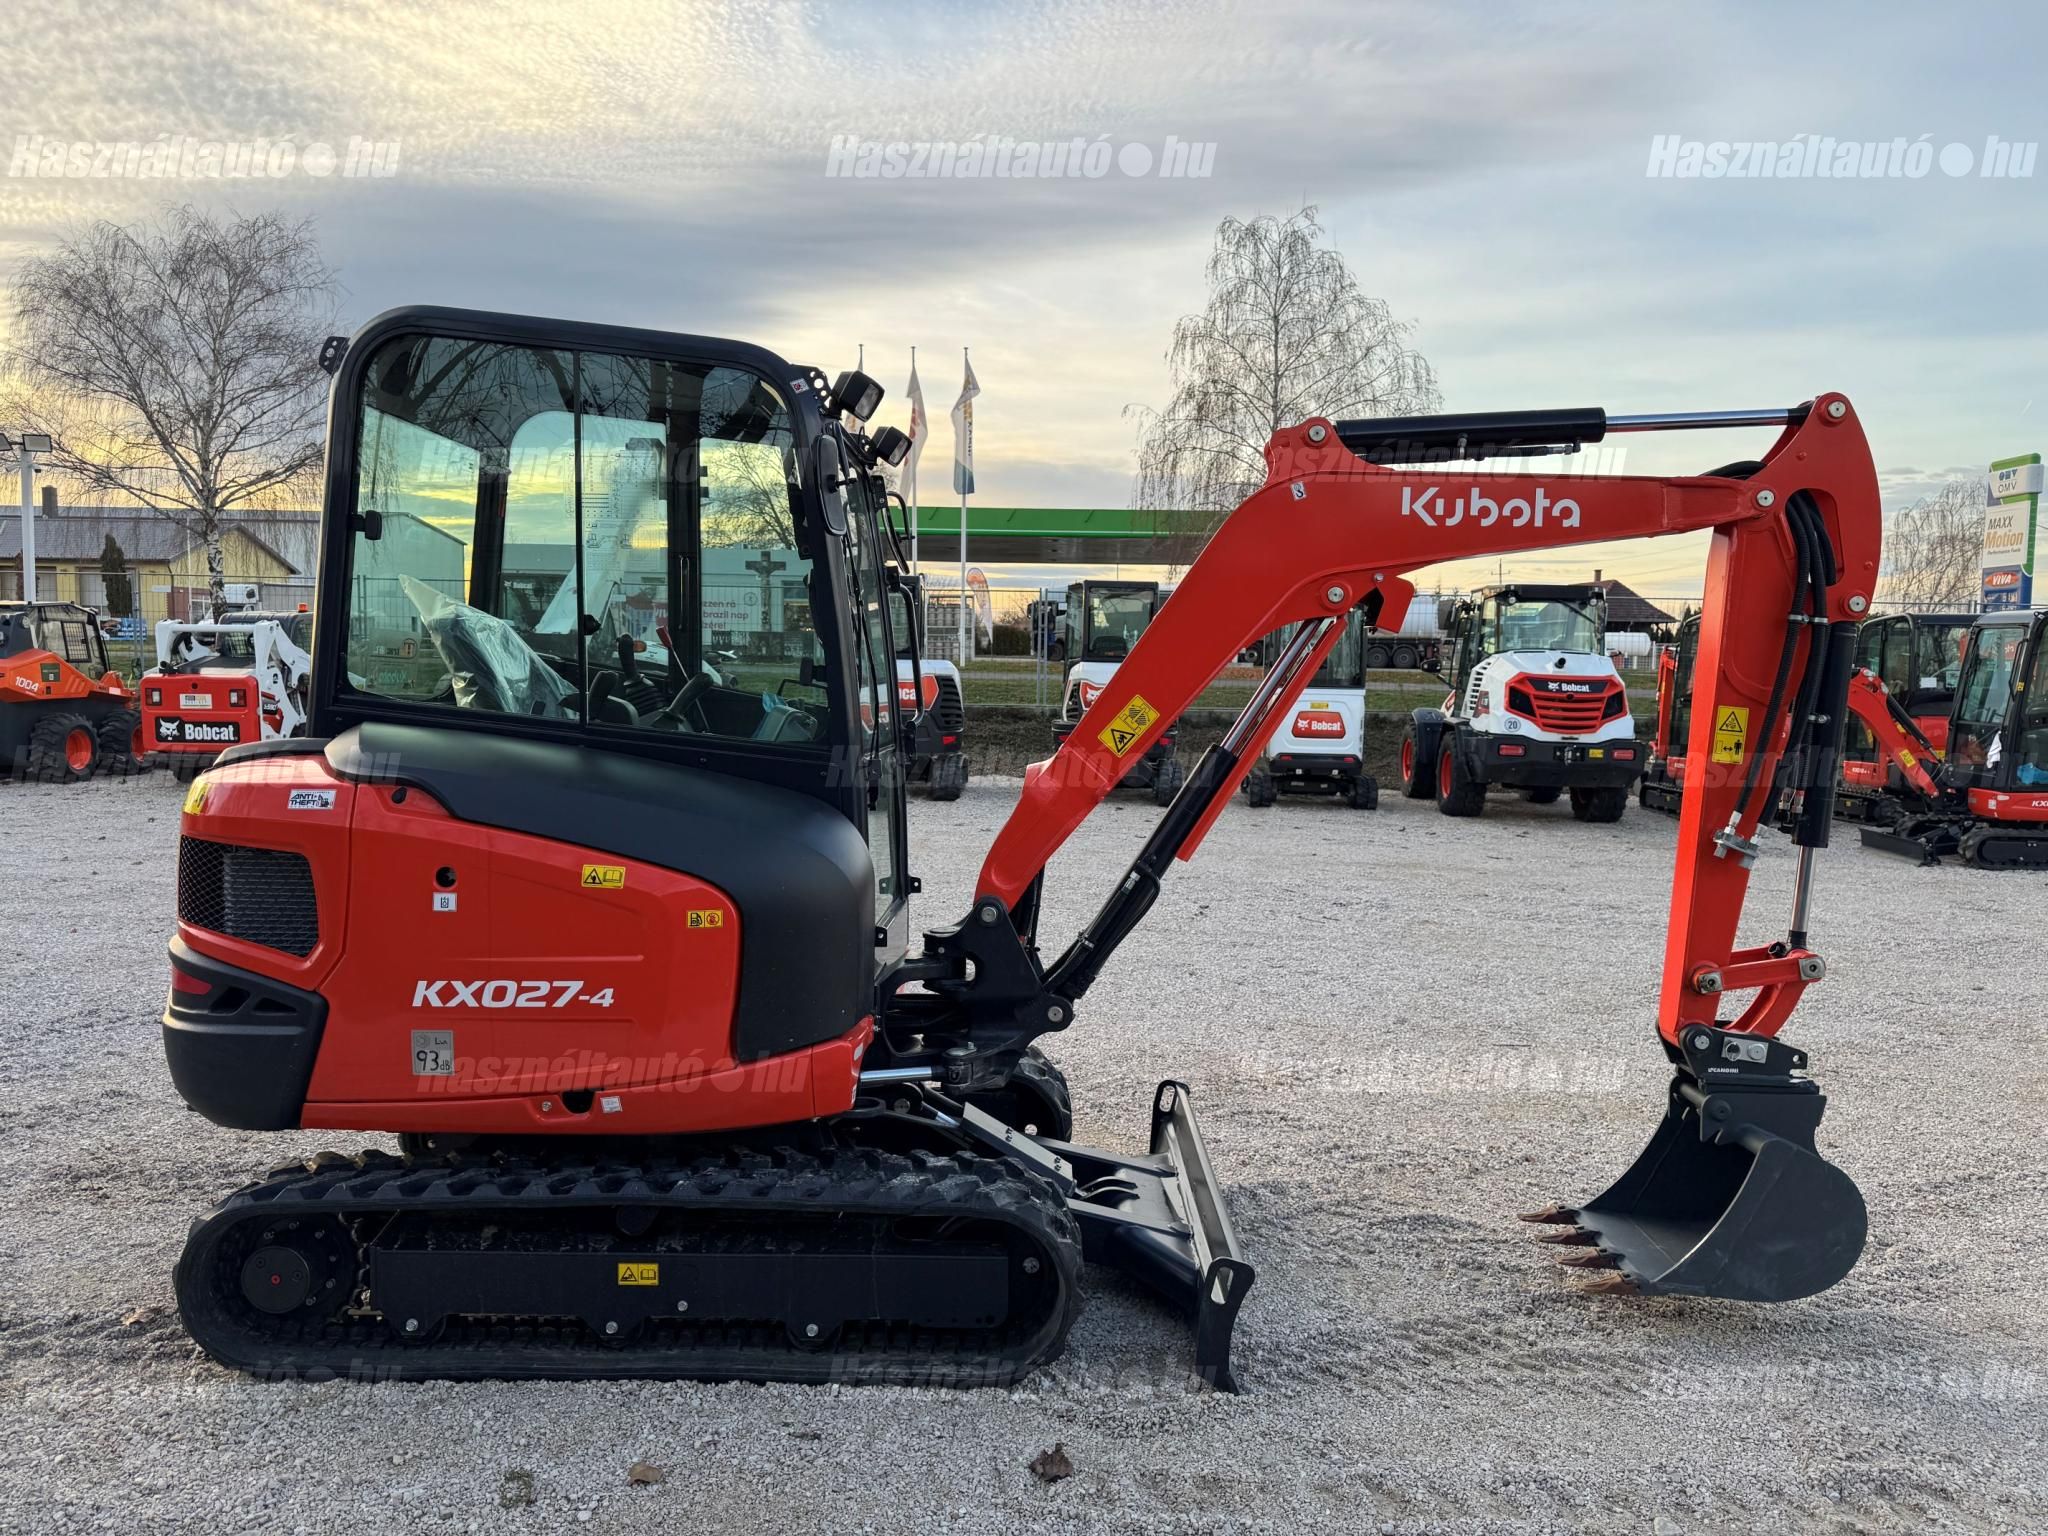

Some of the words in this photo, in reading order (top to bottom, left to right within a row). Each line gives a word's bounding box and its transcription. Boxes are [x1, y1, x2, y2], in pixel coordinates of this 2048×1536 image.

[1997, 481, 2017, 493] OMV
[1401, 486, 1581, 528] Kubota
[1988, 515, 2013, 530] MAXX
[1984, 529, 2024, 549] Motion
[1992, 574, 2012, 586] VIVA
[15, 676, 39, 693] 1004
[1561, 682, 1590, 693] Bobcat
[184, 723, 235, 741] Bobcat
[1311, 720, 1341, 731] Bobcat
[1507, 720, 1518, 730] 20
[412, 980, 615, 1007] KX027-4
[416, 1050, 439, 1071] 93
[440, 1060, 451, 1071] dB
